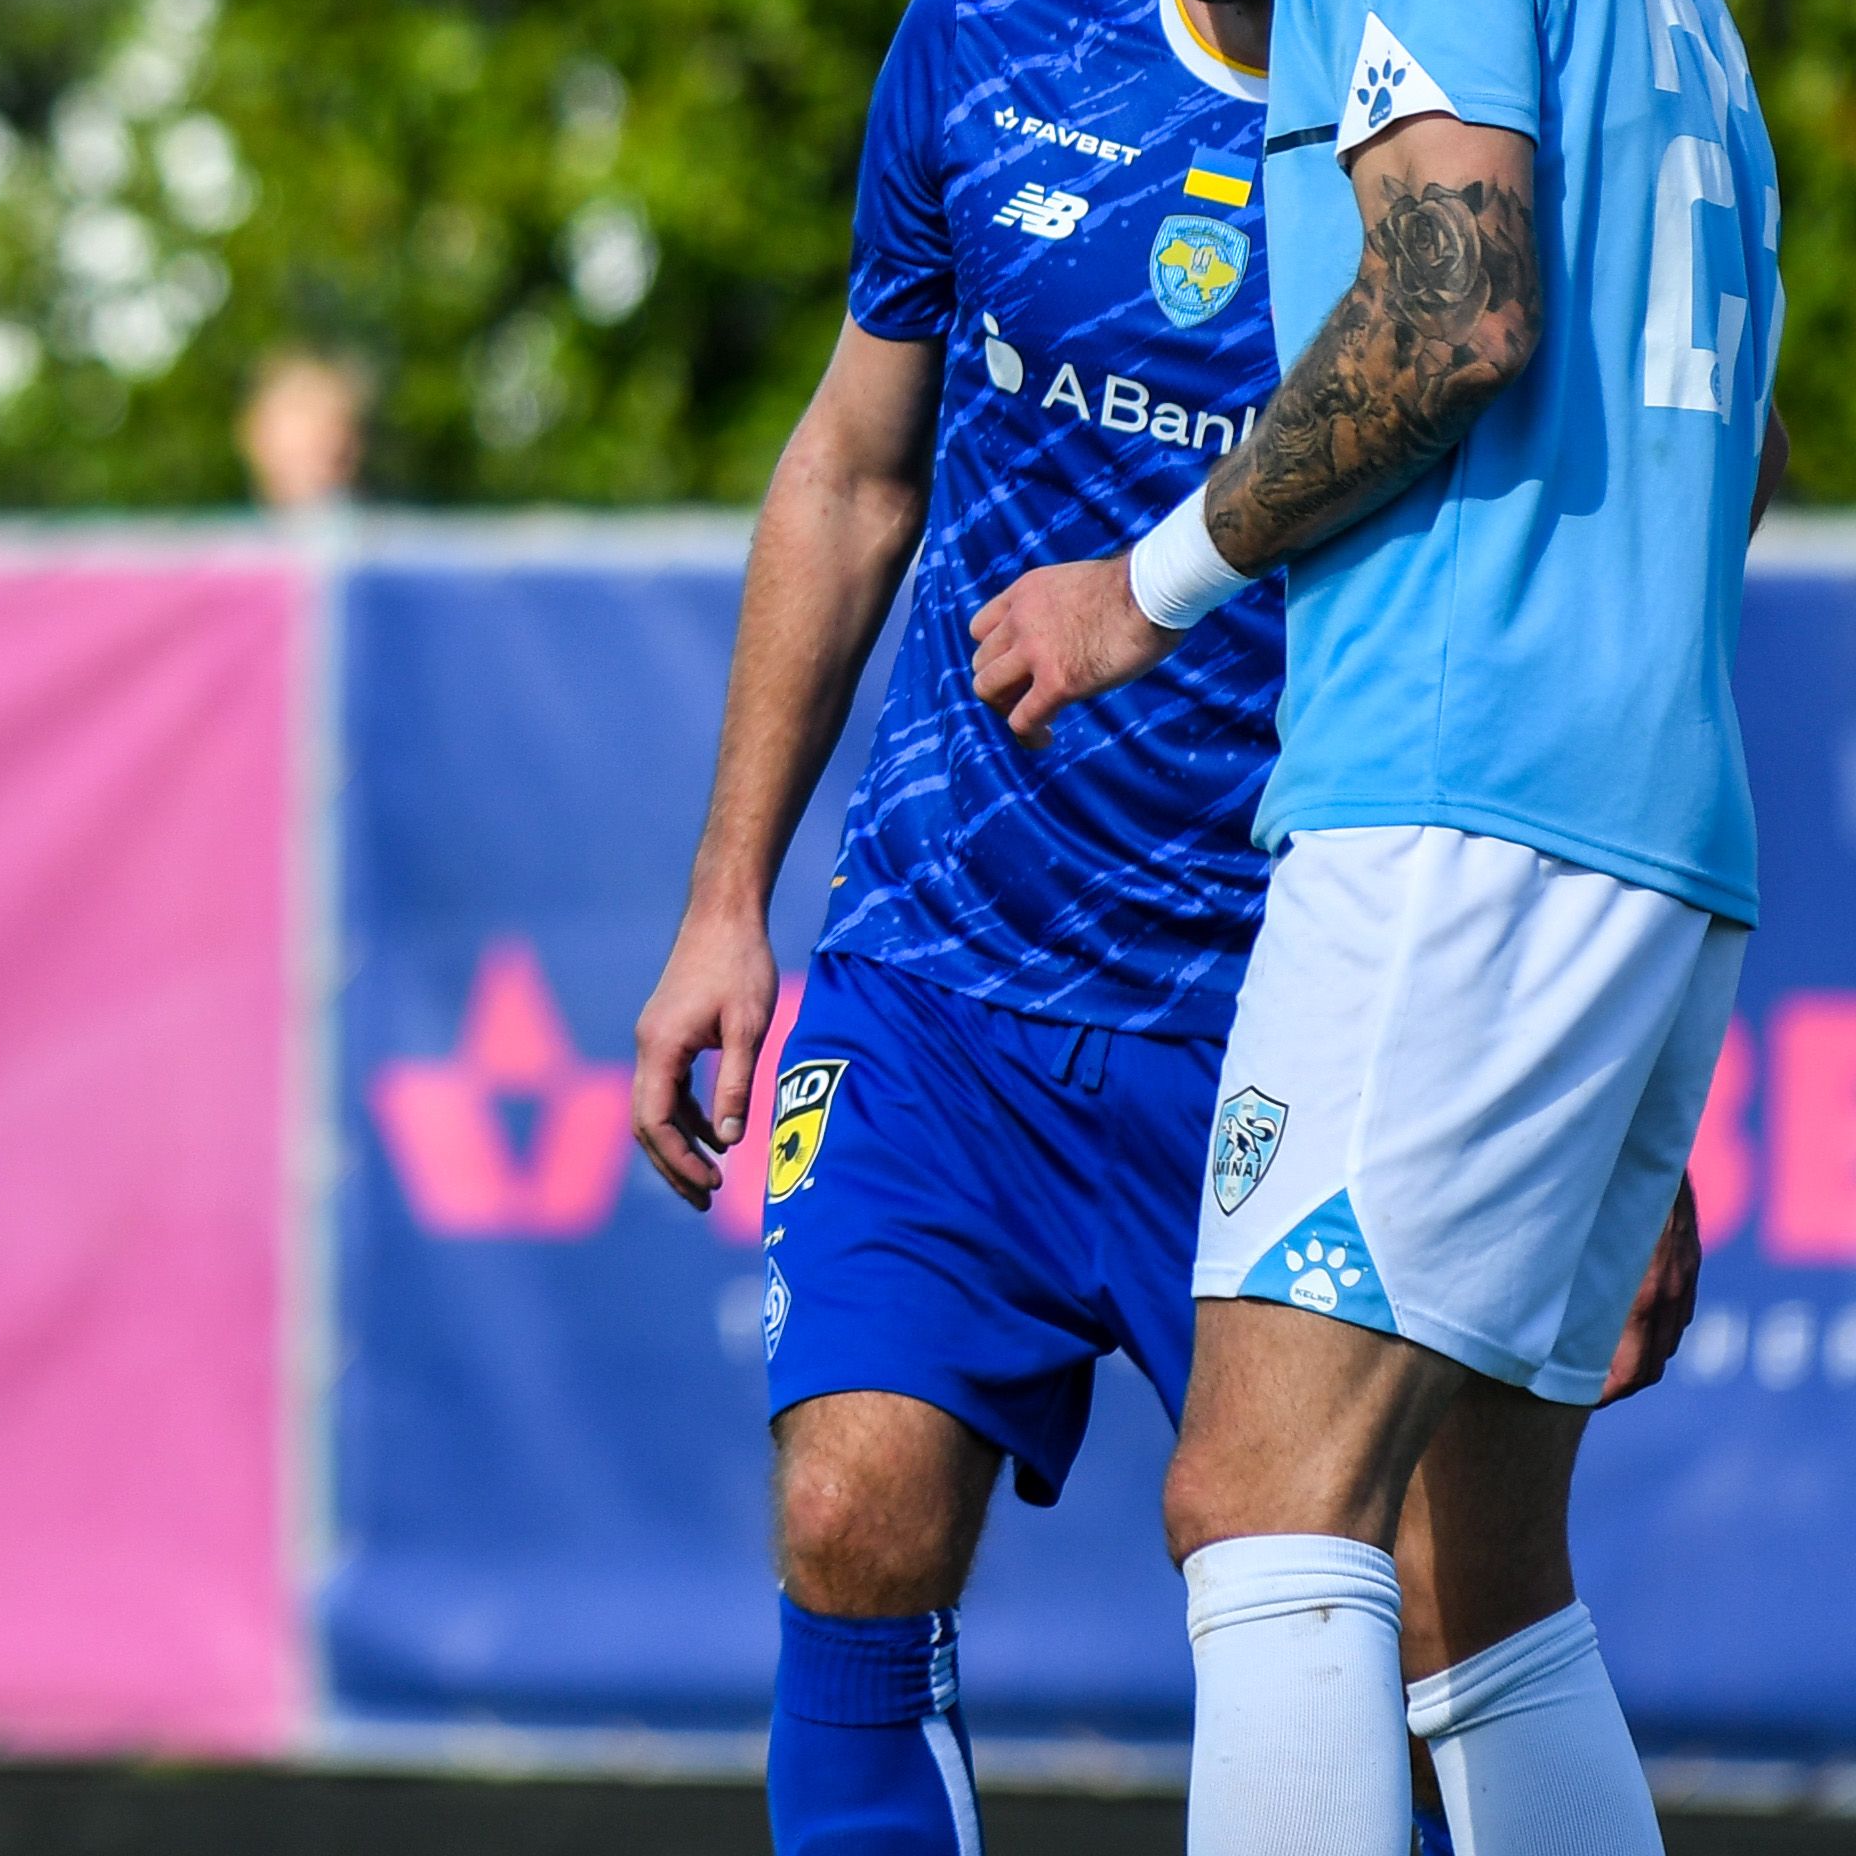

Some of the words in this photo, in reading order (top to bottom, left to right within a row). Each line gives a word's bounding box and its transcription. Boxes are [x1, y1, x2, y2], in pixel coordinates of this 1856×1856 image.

[1021, 116, 1142, 166] FAVBET
[1215, 1159, 1262, 1182] MINAJ
[1294, 1287, 1334, 1305] KELME
